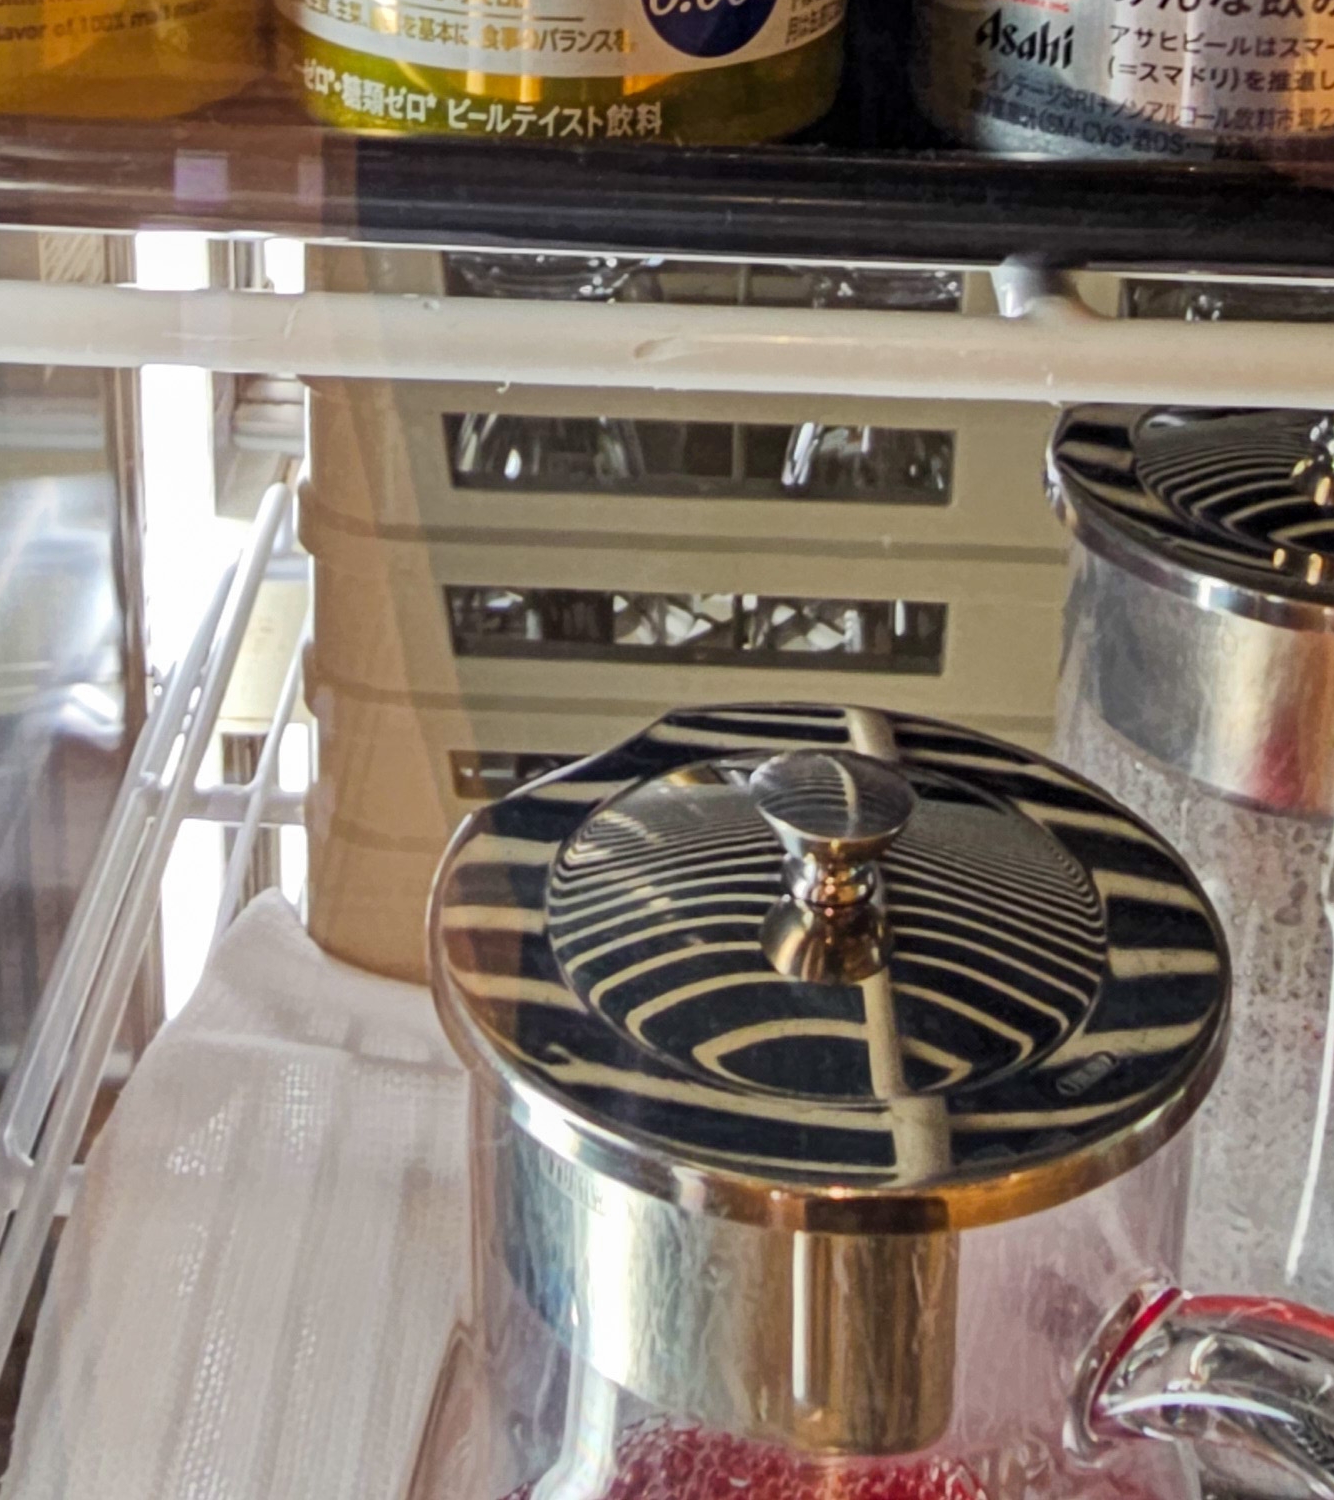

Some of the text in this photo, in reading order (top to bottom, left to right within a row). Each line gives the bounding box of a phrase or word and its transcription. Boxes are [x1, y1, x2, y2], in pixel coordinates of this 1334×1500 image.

[975, 7, 1075, 70] Asahi
[447, 98, 663, 138] ビールテイスト飲料
